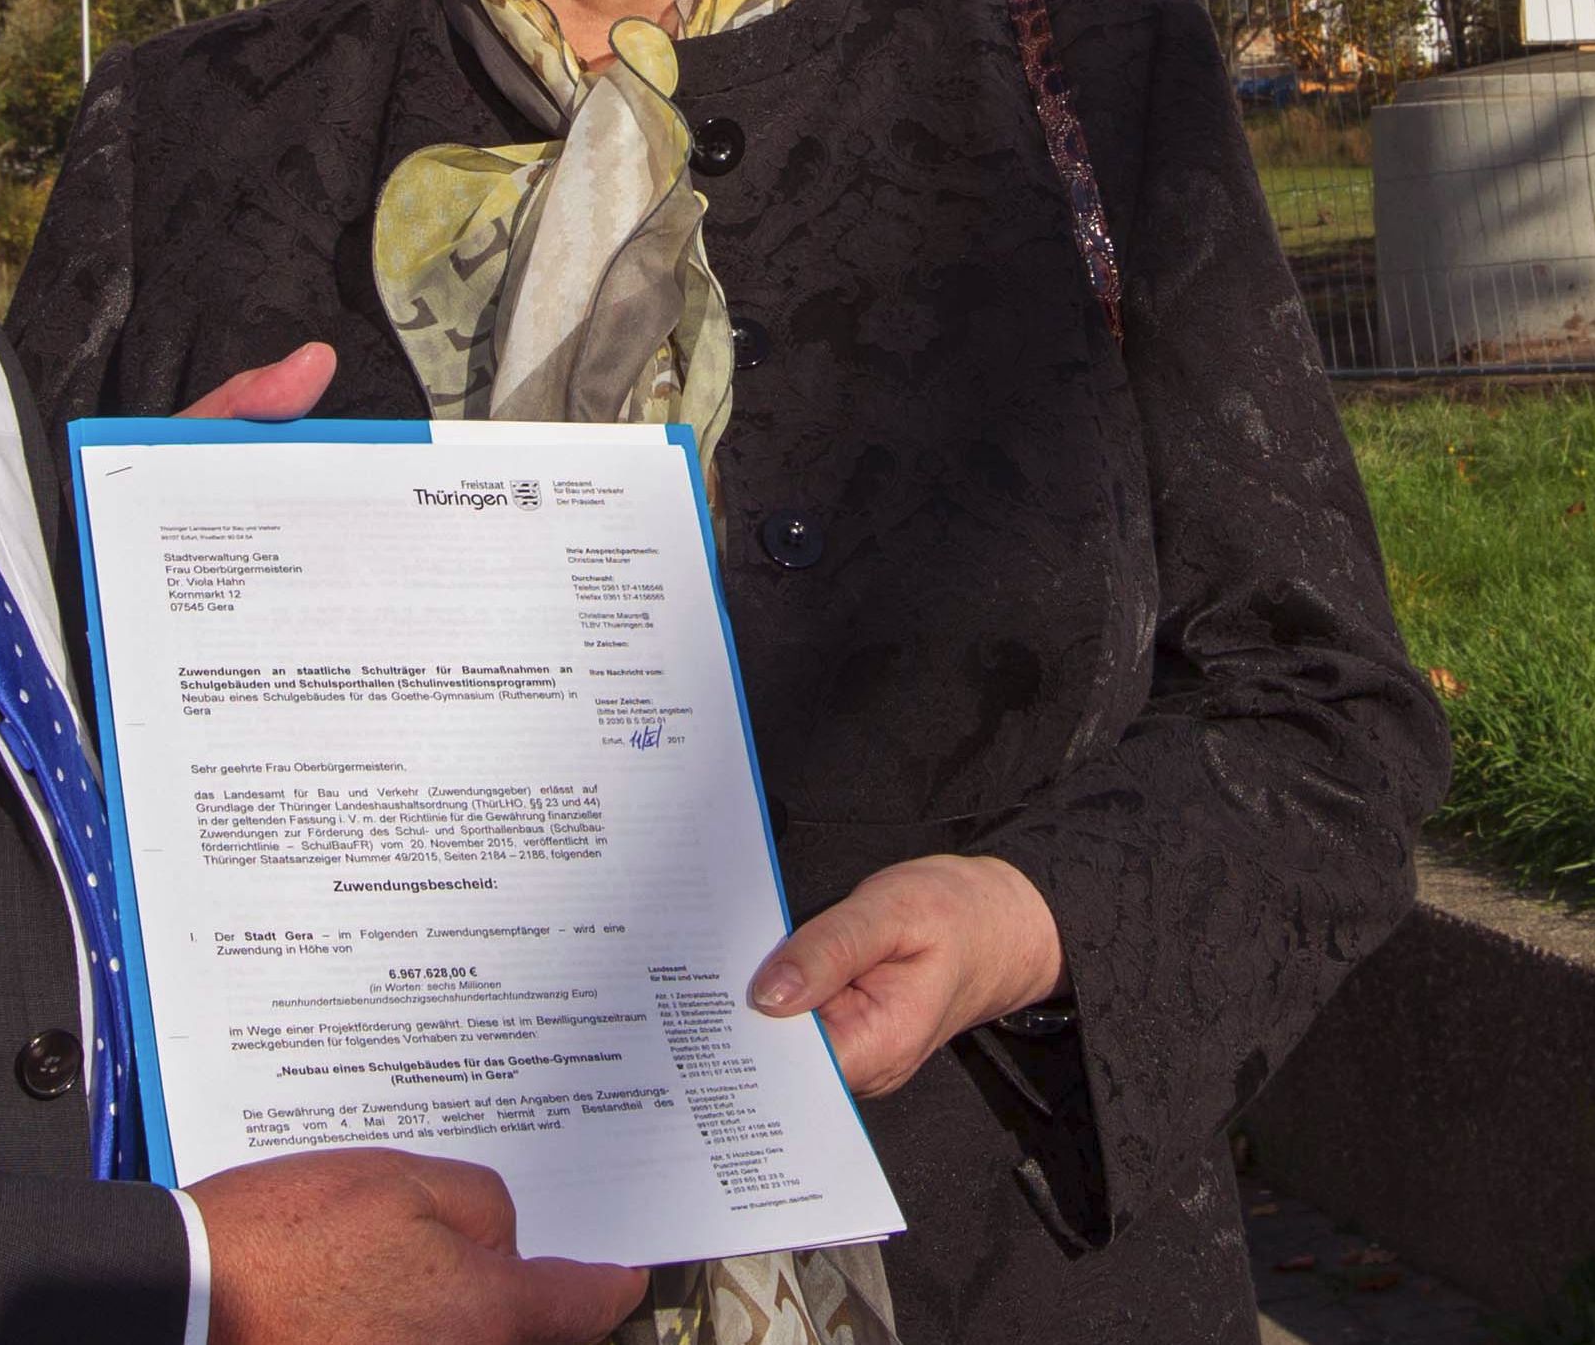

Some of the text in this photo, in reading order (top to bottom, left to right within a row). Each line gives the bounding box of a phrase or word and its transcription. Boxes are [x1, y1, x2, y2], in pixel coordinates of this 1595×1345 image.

[460, 479, 505, 490] Freistaat
[413, 488, 509, 510] Thüringen
[163, 552, 279, 564] Stadtverwaltung Gera
[165, 564, 303, 576] Frau Oberbürgermeisterin
[166, 576, 245, 587] Dr. Viola Hahn
[168, 589, 241, 600] Kornmarkt 12
[169, 601, 235, 612] 07545 Gera
[177, 664, 573, 678] Zuwendungen an staatliche Schulträger für Baumaßnahmen an
[180, 677, 556, 692] Schulgebäuden und Schulsporthallen (Schulinvestitionsprogramm)
[181, 689, 578, 704] Neubau eines Schulgebäudes für das Goethe-Gymnasium (Rutheneum) in
[182, 705, 211, 716] Gera
[667, 736, 685, 744] 2017
[190, 761, 407, 776] Sehr geehrte Frau Oberbürgermeisterin,
[332, 877, 498, 894] Zuwendungsbescheid:
[213, 931, 235, 942] Der
[244, 930, 277, 942] Stadt
[284, 930, 314, 941] Gera
[337, 929, 352, 940] im
[359, 928, 418, 941] Folgenden
[425, 925, 550, 939] Zuwendungsempfänger
[573, 924, 595, 934] wird
[603, 924, 625, 933] eine
[216, 943, 353, 957] Zuwendung in Höhe von
[388, 966, 477, 980] 6.967.628,00 €
[369, 979, 501, 994] (in Worten: sechs Millionen
[571, 988, 597, 999] Euro)
[228, 1013, 647, 1038] im Wege einer Projektförderung gewährt. Diese ist im Bewilligungszeitraum
[230, 1029, 537, 1051] zweckgebunden für folgendes Vorhaben zu verwenden:
[332, 1063, 365, 1074] eines
[367, 1058, 461, 1073] Schulgebäudes
[463, 1057, 481, 1068] für
[483, 1056, 505, 1067] das
[507, 1052, 622, 1066] Goethe-Gymnasium
[390, 1071, 468, 1087] (Rutheneum)
[471, 1070, 483, 1081] in
[242, 1087, 669, 1120] Die Gewährung der Zuwendung basiert auf den Angaben des Zuwendungs-
[245, 1098, 674, 1134] antrags vom 4. Mai 2017, welcher hiermit zum Bestandteil des
[247, 1118, 565, 1148] Zuwendungsbescheides und als verbindlich erklärt wird.
